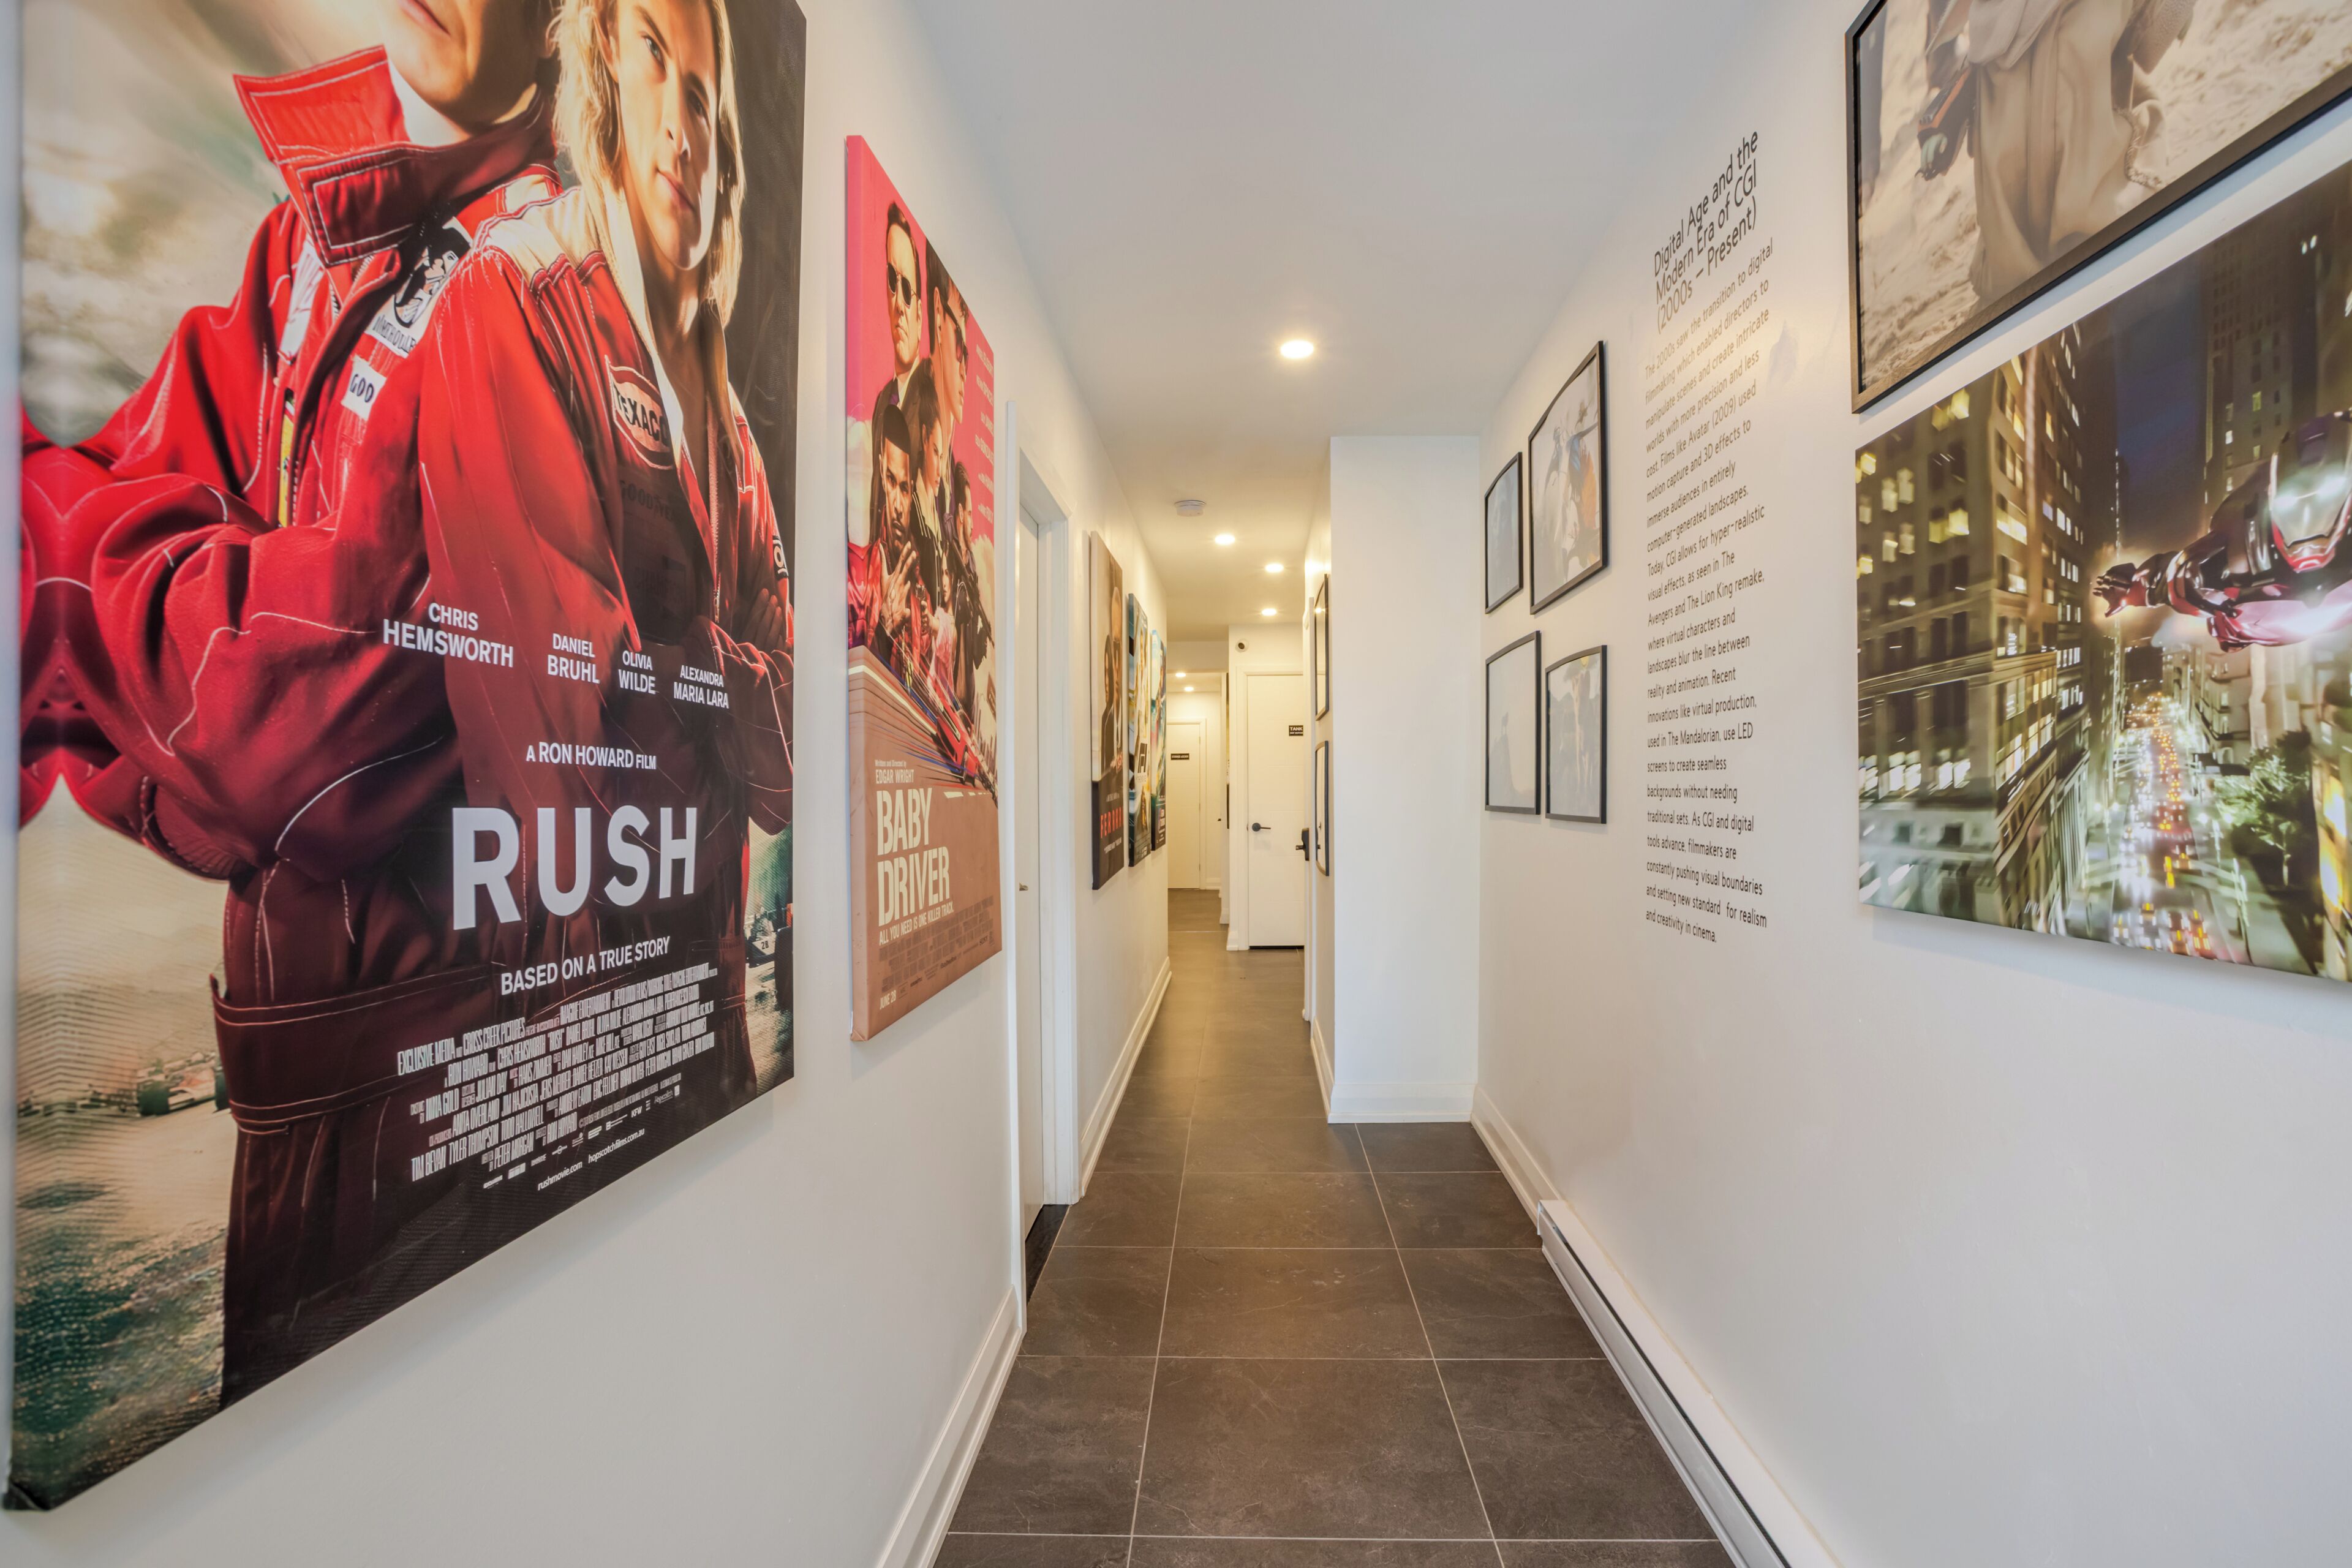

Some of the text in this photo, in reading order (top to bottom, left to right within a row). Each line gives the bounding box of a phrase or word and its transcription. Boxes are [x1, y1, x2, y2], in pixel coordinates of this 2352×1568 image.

[1654, 131, 1758, 277] Digital Age and the
[1656, 161, 1757, 305] Modern Era of CGI
[1657, 279, 1692, 334] (2000s
[1708, 197, 1757, 276] Present)
[1660, 449, 1675, 468] Films
[1676, 439, 1687, 456] like
[1688, 420, 1710, 447] Avatar
[1712, 394, 1736, 429] (2009)
[1738, 379, 1756, 407] used
[1646, 419, 1751, 502] motion capture and 3D effects to
[1647, 460, 1736, 528] immerse audiences in entirely
[1647, 504, 1707, 553] computer-generated
[1666, 549, 1676, 568] CGI
[1678, 543, 1697, 562] allows
[1698, 535, 1709, 551] for
[1711, 504, 1765, 546] hyper-realistic
[1648, 583, 1663, 601] visual
[1687, 571, 1695, 584] as
[1696, 564, 1711, 580] seen
[1713, 558, 1719, 572] in
[1721, 551, 1735, 567] The
[428, 602, 478, 631] CHRIS
[1648, 608, 1673, 627] Avengers
[1675, 598, 1686, 616] and
[1687, 595, 1699, 610] The
[1700, 590, 1715, 606] Lion
[1717, 582, 1733, 599] King
[383, 619, 514, 668] HEMSWORTH
[552, 633, 595, 658] DANIEL
[1648, 607, 1735, 651] where virtual characters and
[547, 654, 600, 684] BRUHL
[622, 650, 652, 671] OLIVIA
[1648, 635, 1750, 674] landscapes blur the line between
[618, 669, 656, 695] WILDE
[679, 665, 724, 687] ALEXANDRA
[1648, 684, 1665, 699] reality
[1666, 679, 1676, 695] and
[1712, 667, 1736, 685] Recent
[674, 681, 729, 709] MARIA LARA
[1648, 709, 1679, 723] innovations
[1680, 704, 1691, 718] like
[1692, 698, 1713, 716] virtual
[1648, 734, 1660, 748] used
[1661, 734, 1667, 747] in
[1668, 731, 1679, 745] The
[1723, 728, 1736, 741] use
[1738, 722, 1753, 740] LED
[526, 742, 657, 770] A RON HOWARD FILM
[1647, 755, 1727, 772] screens to create seamless
[875, 769, 914, 784] EDGAR WRIGHT
[1647, 783, 1738, 804] backgrounds without needing
[876, 787, 932, 856] BABY
[1647, 810, 1675, 824] traditional
[1692, 811, 1700, 827] As
[1702, 811, 1714, 827] CGI
[1716, 813, 1729, 829] and
[1730, 814, 1754, 835] digital
[1647, 834, 1660, 848] tools
[1688, 838, 1723, 858] filmmakers
[1725, 847, 1736, 860] are
[451, 805, 698, 930] RUSH
[1646, 862, 1763, 895] constantly pushing visual boundaries
[878, 846, 950, 927] DRIVER
[1646, 884, 1767, 928] and setting new standard for realism
[1646, 910, 1656, 922] and
[1657, 914, 1684, 935] creativity
[1685, 919, 1691, 934] in
[880, 930, 889, 946] ALL
[890, 924, 900, 941] YOU
[901, 918, 913, 936] NEED
[913, 916, 918, 930] IS
[919, 913, 927, 928] ONE
[927, 907, 941, 924] KILLER
[501, 935, 671, 995] BASED ON A TRUE STORY
[880, 993, 890, 1010] JUNE
[588, 1128, 644, 1163] hopscotchfilms.com.au
[537, 1161, 582, 1191] rushmovie.com
